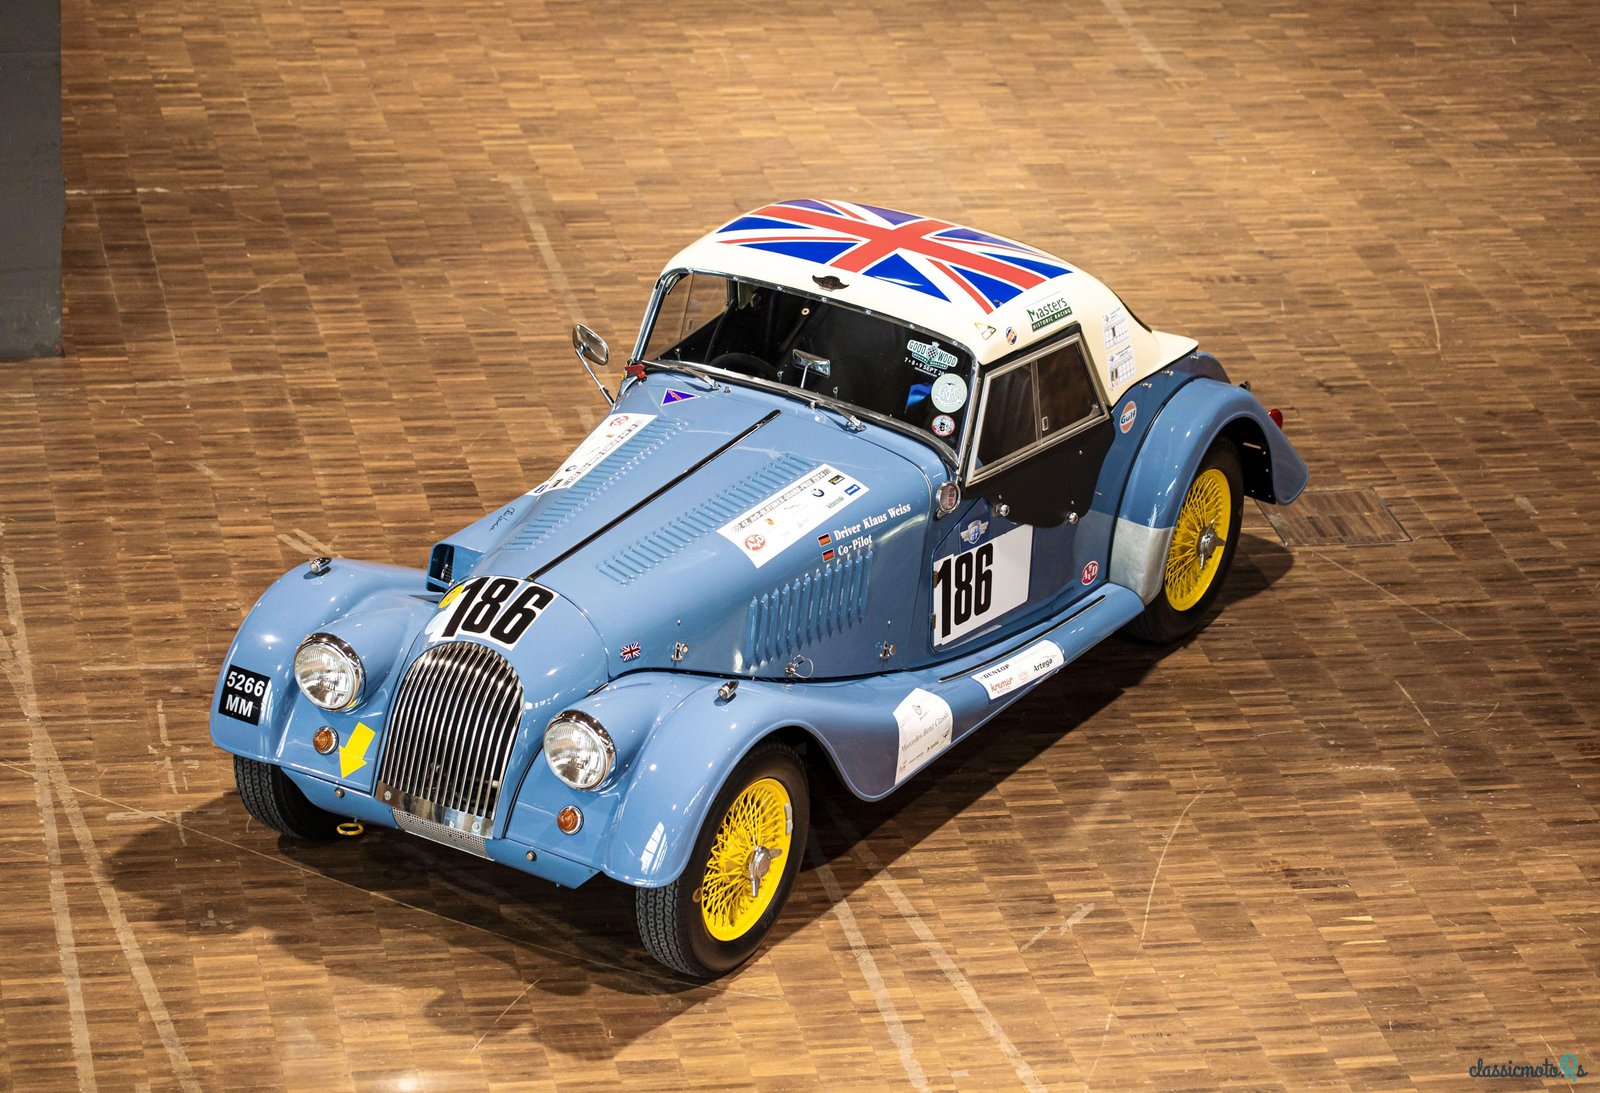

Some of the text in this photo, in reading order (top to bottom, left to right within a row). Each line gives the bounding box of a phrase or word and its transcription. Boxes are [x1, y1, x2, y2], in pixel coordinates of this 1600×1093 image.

[1026, 298, 1068, 322] Masters
[1033, 308, 1072, 329] HISTORIC RACING
[909, 341, 926, 355] GOOD
[938, 350, 957, 366] WOOD
[923, 364, 938, 374] SEPT
[1121, 410, 1135, 424] Gulf
[833, 503, 911, 541] Driver Klaus Weiss
[838, 534, 873, 556] Co-Pilot
[934, 543, 994, 638] 186
[441, 577, 554, 645] 186
[983, 663, 1010, 679] DUNLOP
[1033, 658, 1053, 672] Artega
[226, 671, 265, 697] 5266
[990, 676, 1014, 692] kremer
[225, 694, 254, 717] MM
